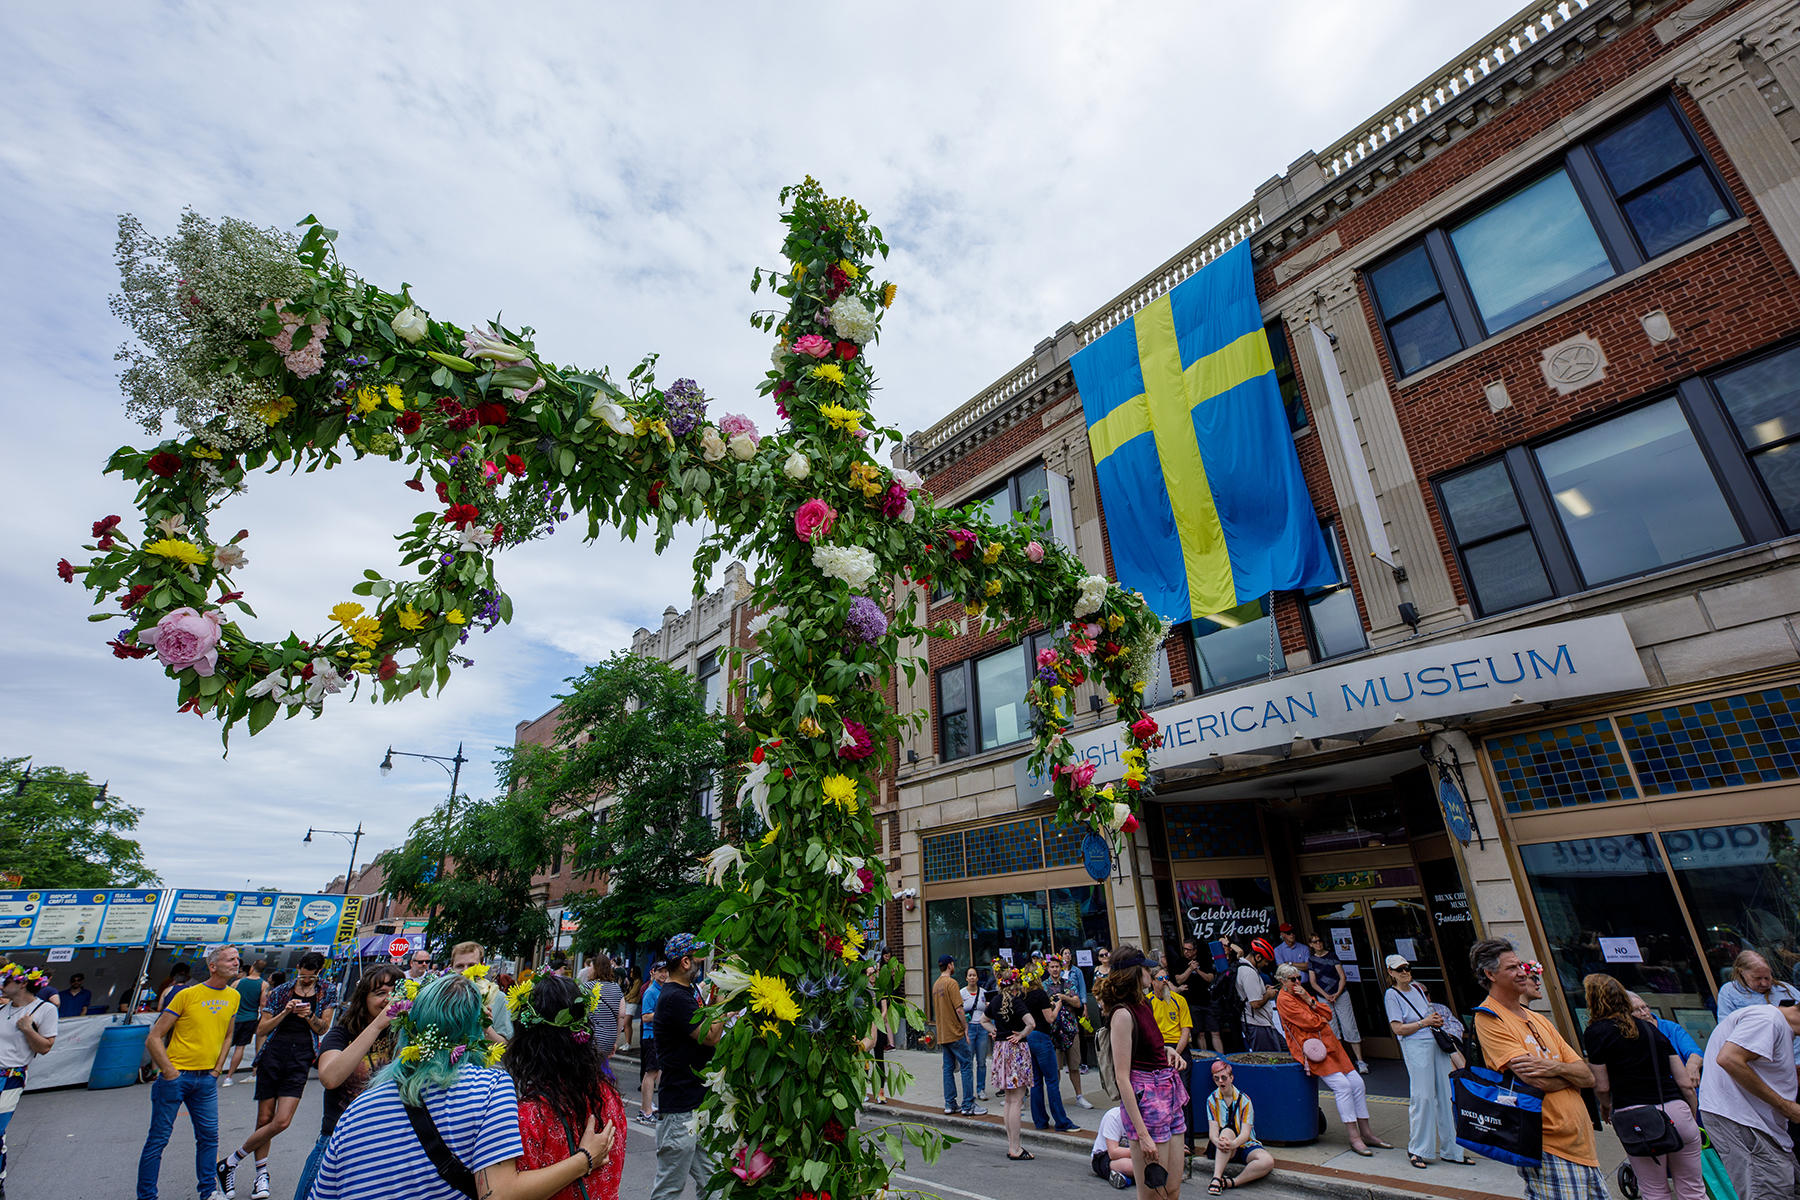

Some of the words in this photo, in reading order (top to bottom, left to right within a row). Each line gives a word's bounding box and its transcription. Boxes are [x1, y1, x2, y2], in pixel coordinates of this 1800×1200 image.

[1028, 739, 1120, 788] SWISH
[1147, 691, 1319, 754] MERICAN
[1340, 644, 1578, 712] MUSEUM
[337, 897, 360, 943] BEVVIES
[1187, 905, 1267, 923] Celebrating
[1193, 922, 1215, 939] 45
[1219, 918, 1271, 937] Years!
[390, 943, 409, 952] STOP
[201, 999, 229, 1007] SVERIGE
